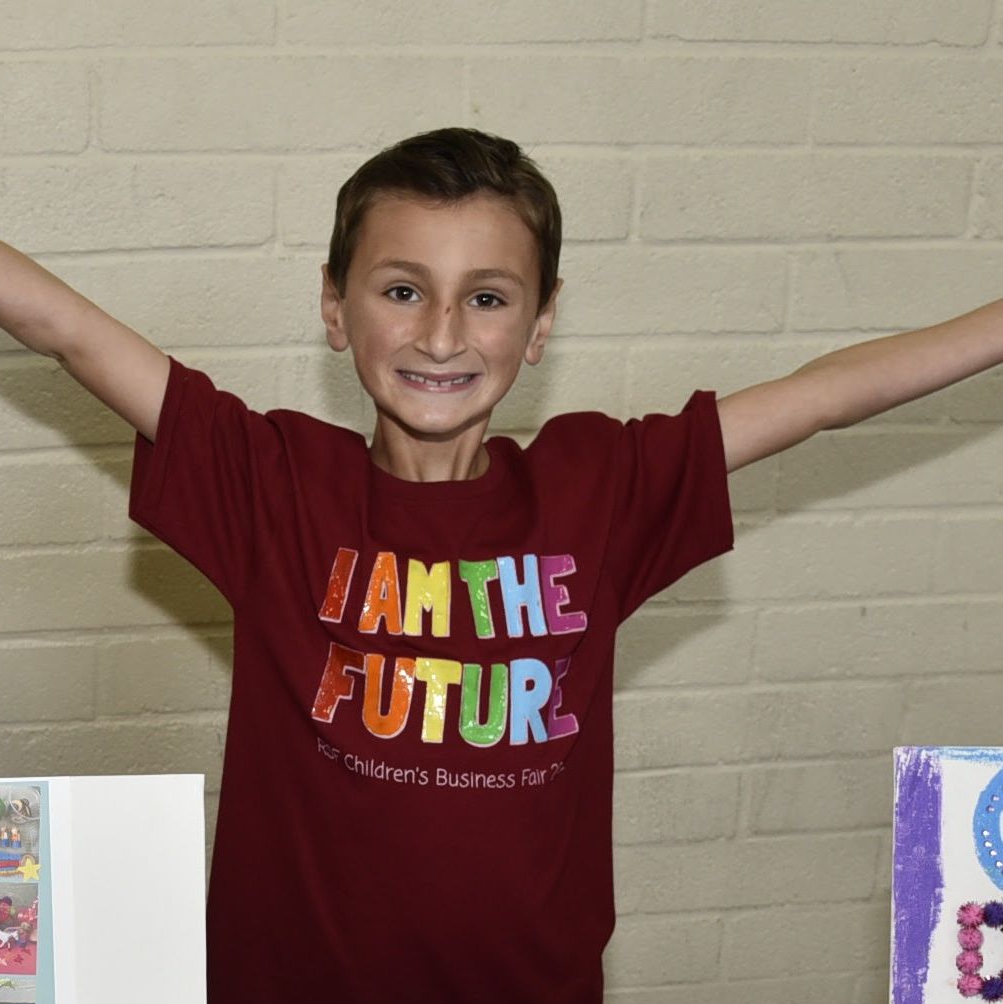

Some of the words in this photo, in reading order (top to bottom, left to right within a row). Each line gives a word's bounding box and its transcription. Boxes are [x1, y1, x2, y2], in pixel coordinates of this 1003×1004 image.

[318, 547, 358, 623] I
[358, 552, 452, 638] AM
[458, 554, 588, 640] THE
[312, 642, 580, 748] FUTURE
[344, 753, 428, 786] Children's
[436, 768, 516, 789] Business
[522, 768, 546, 788] Fair
